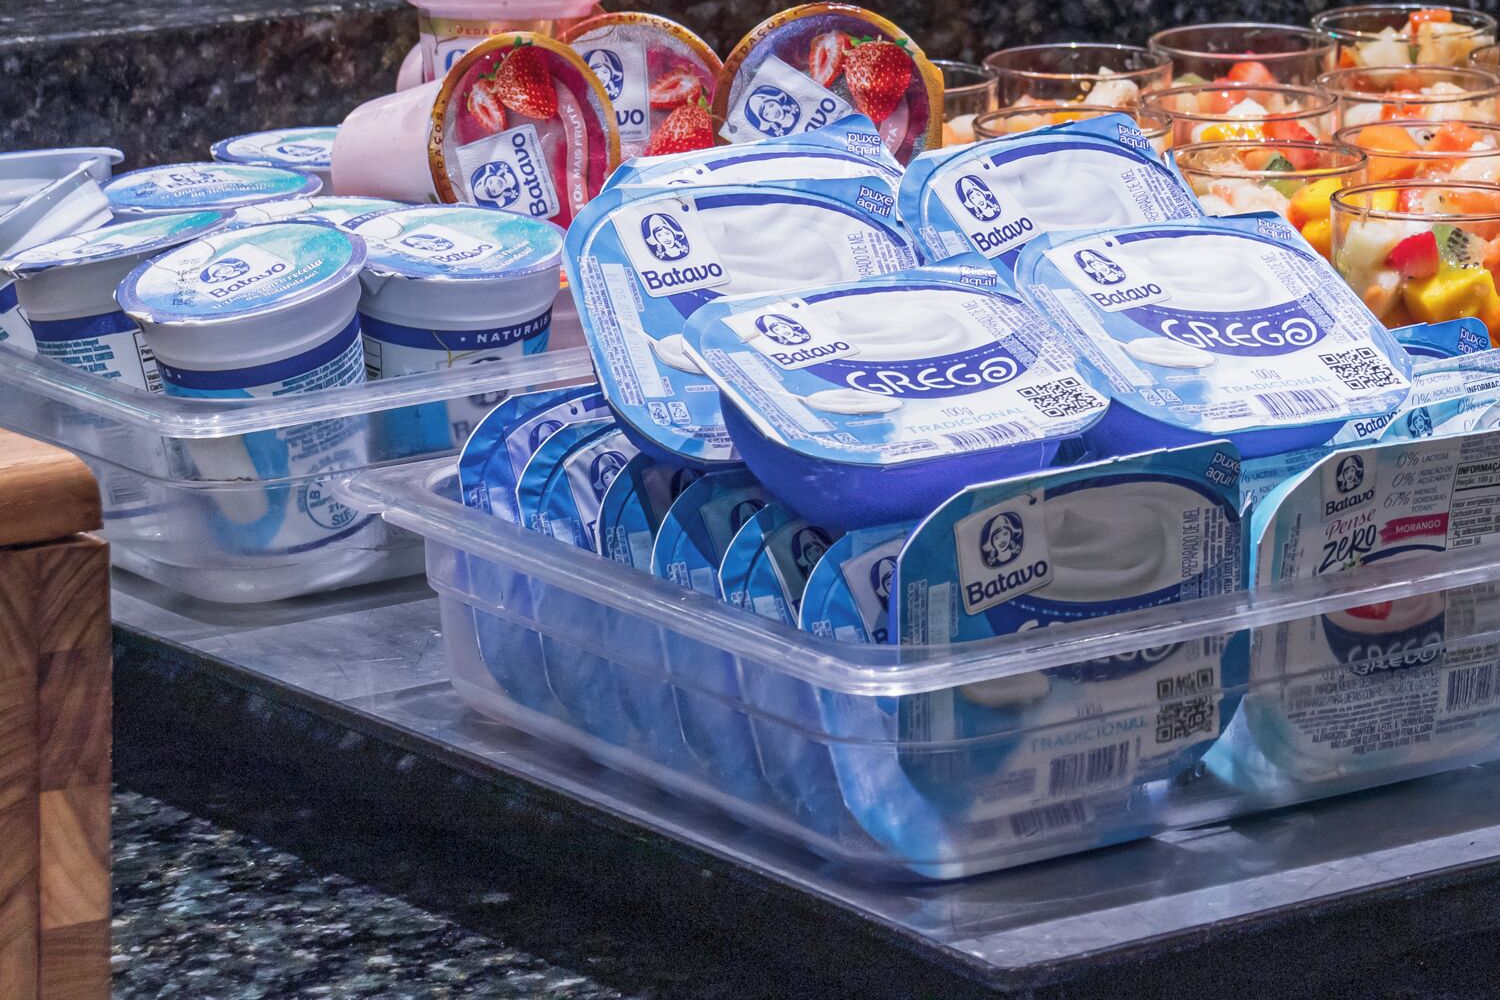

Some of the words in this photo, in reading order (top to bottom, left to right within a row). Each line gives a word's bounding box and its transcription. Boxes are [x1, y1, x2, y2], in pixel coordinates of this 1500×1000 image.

[566, 104, 582, 146] FRUTA
[848, 132, 881, 145] puxe
[1119, 135, 1151, 151] aqui!
[847, 144, 881, 156] aqui!
[574, 149, 583, 177] MAIS
[512, 131, 548, 218] Batavo
[860, 187, 894, 206] puxe
[857, 198, 891, 218] aqui!
[972, 214, 1033, 253] Batavo
[1257, 218, 1291, 233] puxe
[1258, 227, 1292, 241] aqui!
[430, 243, 494, 263] Batavo
[208, 263, 287, 299] Batavo
[641, 262, 723, 290] Batavo
[959, 275, 998, 287] aqui!
[1090, 283, 1162, 307] Batavo
[476, 315, 550, 344] NATURAIS
[1161, 317, 1318, 349] GREGO
[1460, 328, 1488, 347] puxe
[771, 340, 850, 365] Batavo
[847, 358, 1018, 396] GREGO
[1219, 375, 1331, 394] TRADICIONAL
[1250, 368, 1281, 381] 100g
[906, 406, 1029, 434] TRADICIONAL
[940, 405, 973, 419] 100g
[1211, 451, 1241, 473] puxe
[1397, 451, 1419, 469] 0%
[1421, 452, 1450, 464] LACTOSE
[1205, 466, 1237, 487] aqui!
[1391, 472, 1416, 488] 0%
[1414, 486, 1438, 496] MENOS
[1325, 489, 1375, 517] Batavo
[1325, 508, 1377, 541] Pense
[1395, 519, 1441, 535] MORANGO
[965, 560, 1048, 606] Batavo
[1031, 715, 1149, 752] TRADICIONAL
